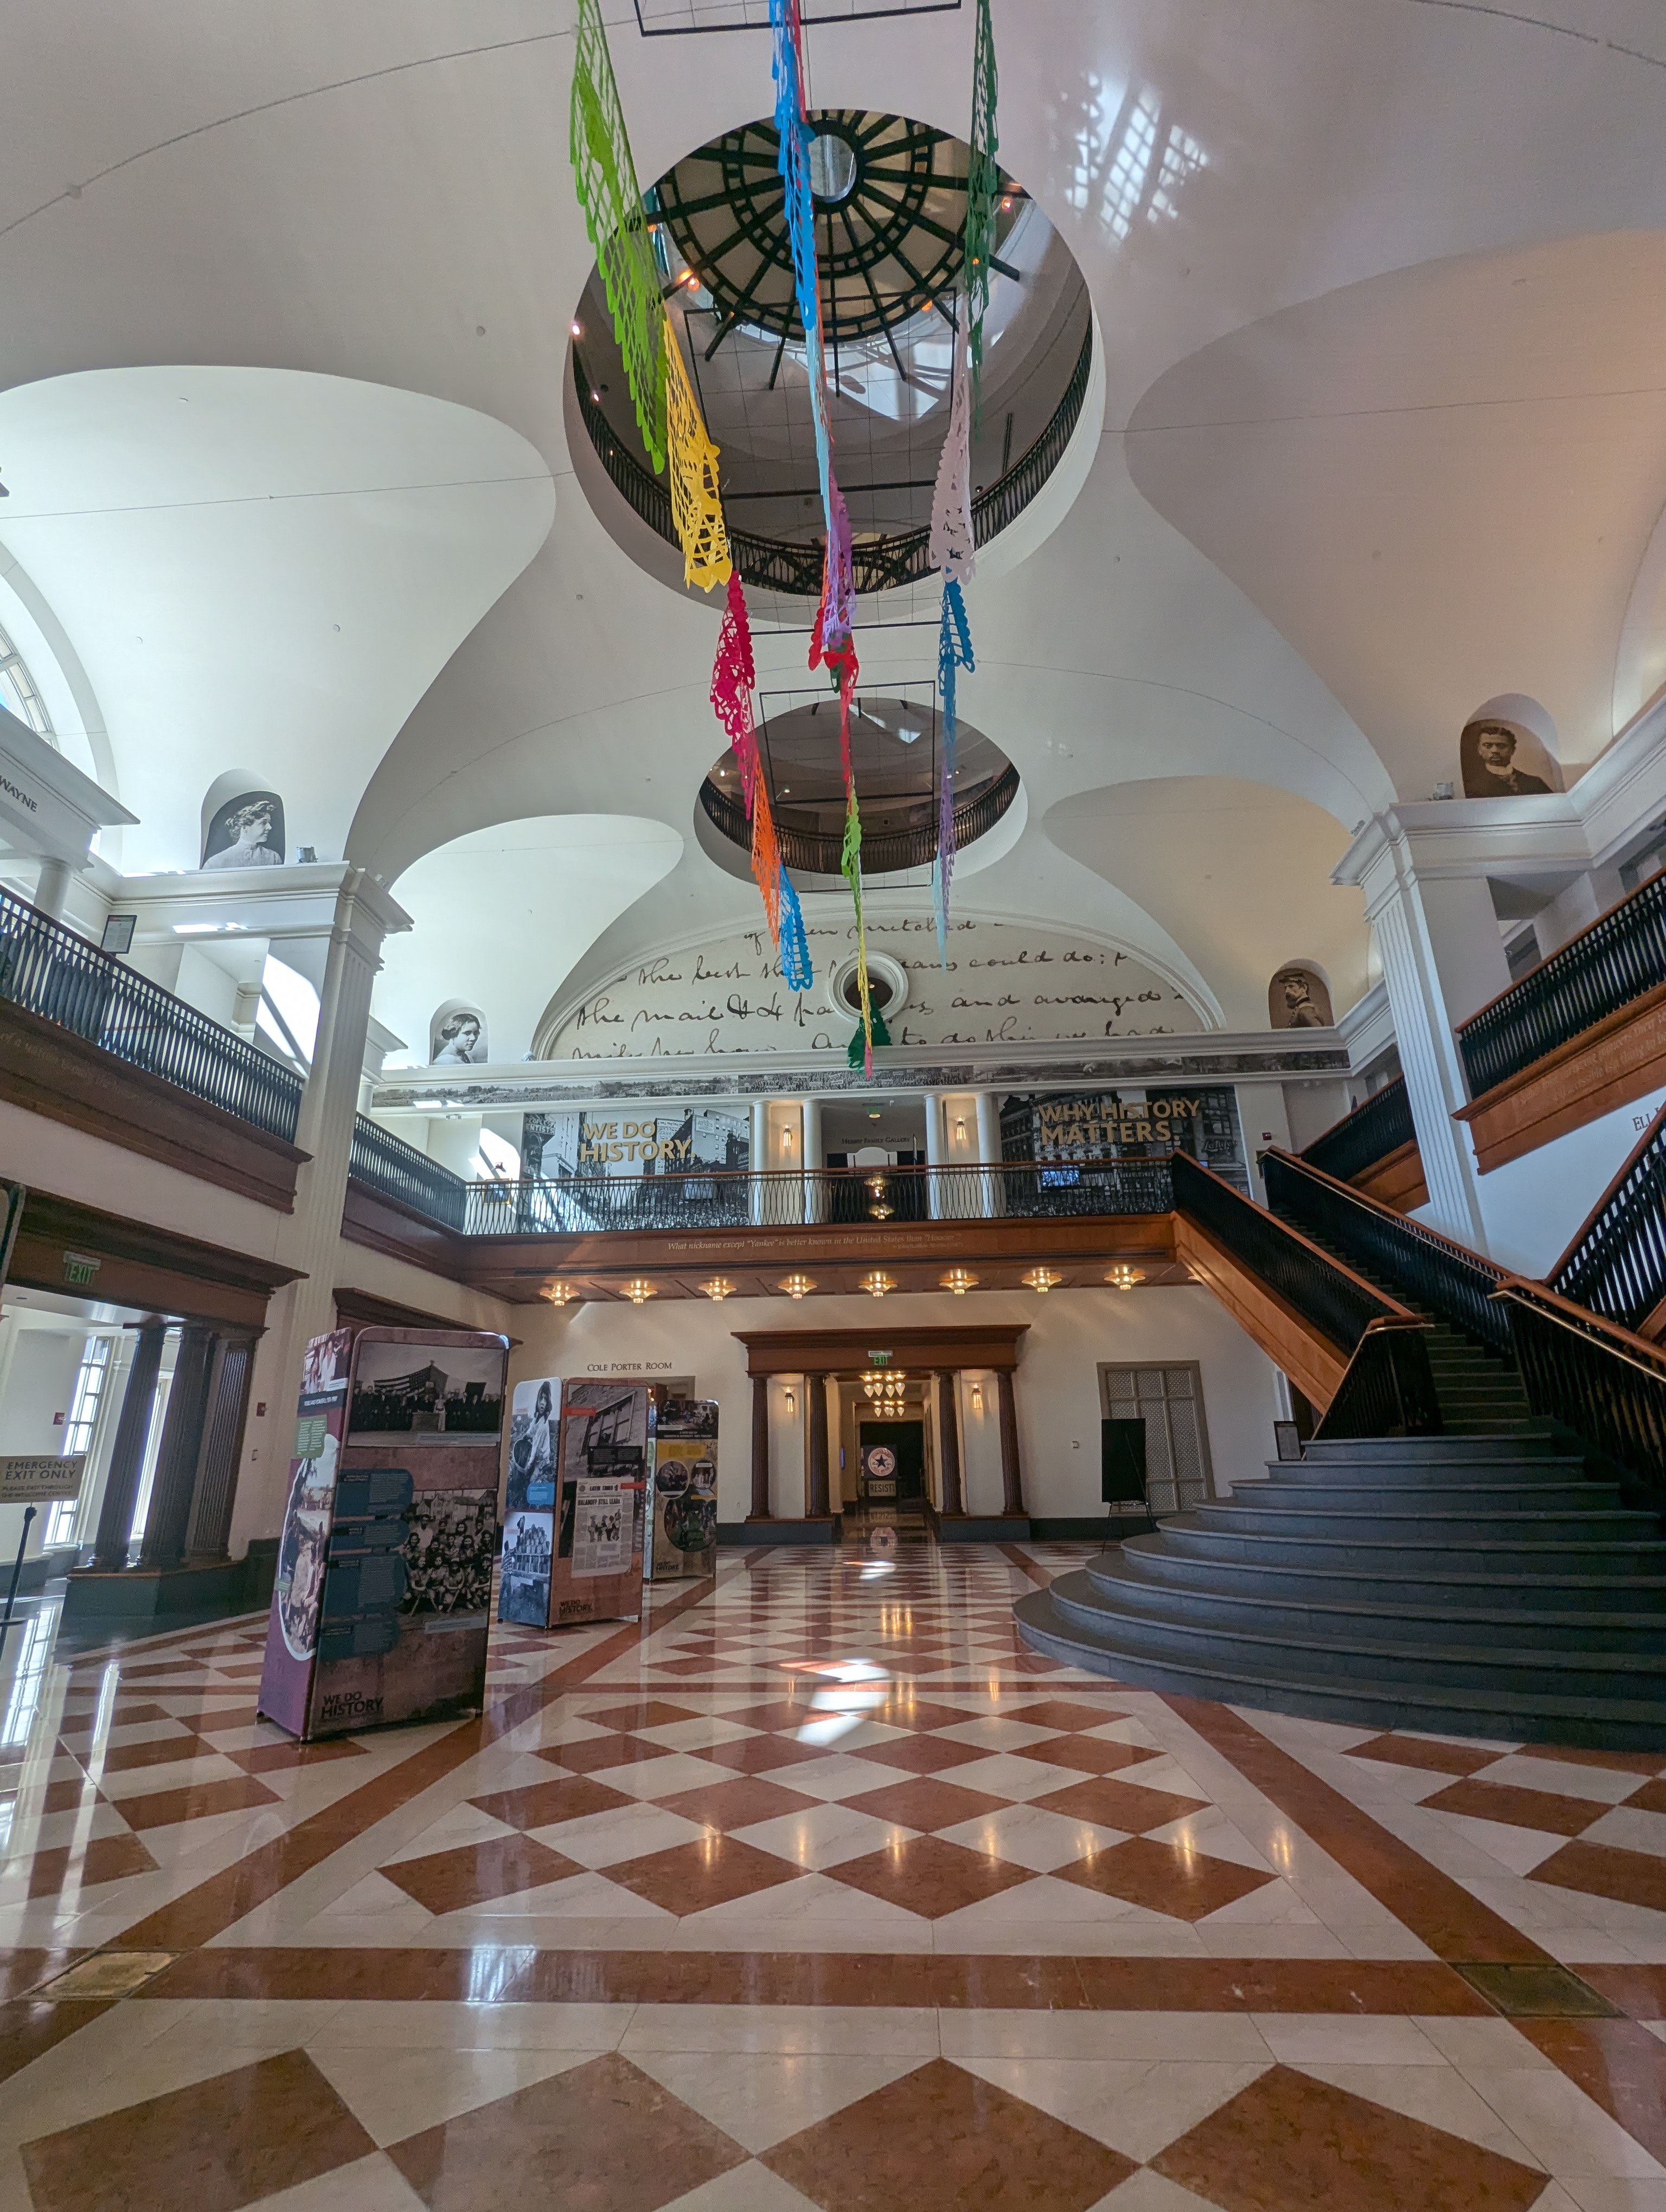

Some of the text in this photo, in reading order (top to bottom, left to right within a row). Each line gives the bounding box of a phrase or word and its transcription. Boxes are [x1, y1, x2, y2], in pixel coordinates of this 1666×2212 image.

[0, 775, 37, 812] WAYNE
[1038, 1099, 1200, 1122] WHY HISTORY
[583, 1120, 656, 1140] WE DO
[1041, 1121, 1181, 1145] MATTERS.
[580, 1139, 697, 1163] HISTORY.
[668, 1242, 687, 1250] What
[688, 1240, 721, 1249] nickname
[723, 1240, 745, 1250] except
[779, 1238, 785, 1246] is
[786, 1238, 808, 1246] better
[808, 1237, 832, 1245] known
[842, 1236, 855, 1244] the
[856, 1235, 881, 1244] United
[883, 1234, 905, 1243] States
[69, 1263, 93, 1284] EXIT
[587, 1362, 672, 1372] COLE PORTER ROOM
[874, 1356, 888, 1366] EXIT
[7, 1461, 78, 1470] EMERGENCY
[5, 1470, 76, 1480] EXIT ONLY
[323, 1691, 362, 1706] WE DO
